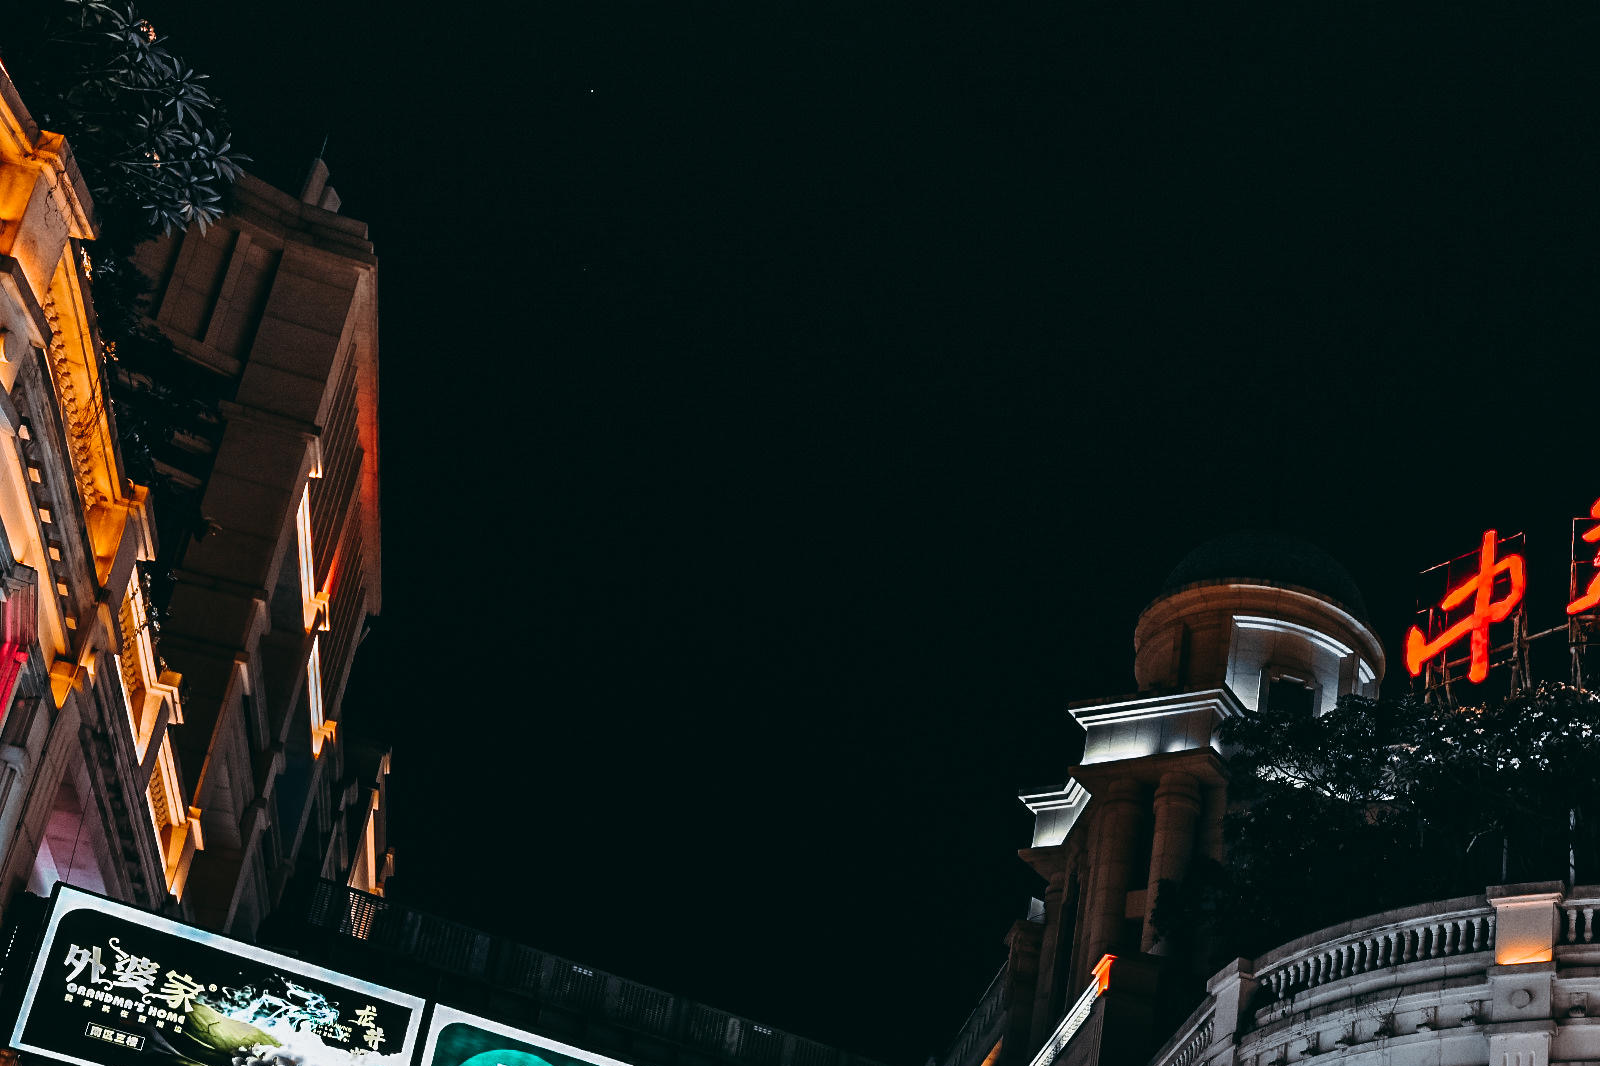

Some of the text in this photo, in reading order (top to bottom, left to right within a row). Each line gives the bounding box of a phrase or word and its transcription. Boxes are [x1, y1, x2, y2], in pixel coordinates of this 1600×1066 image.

[63, 937, 205, 1013] 外婆家
[66, 982, 186, 1025] GRANDMA'S HOME
